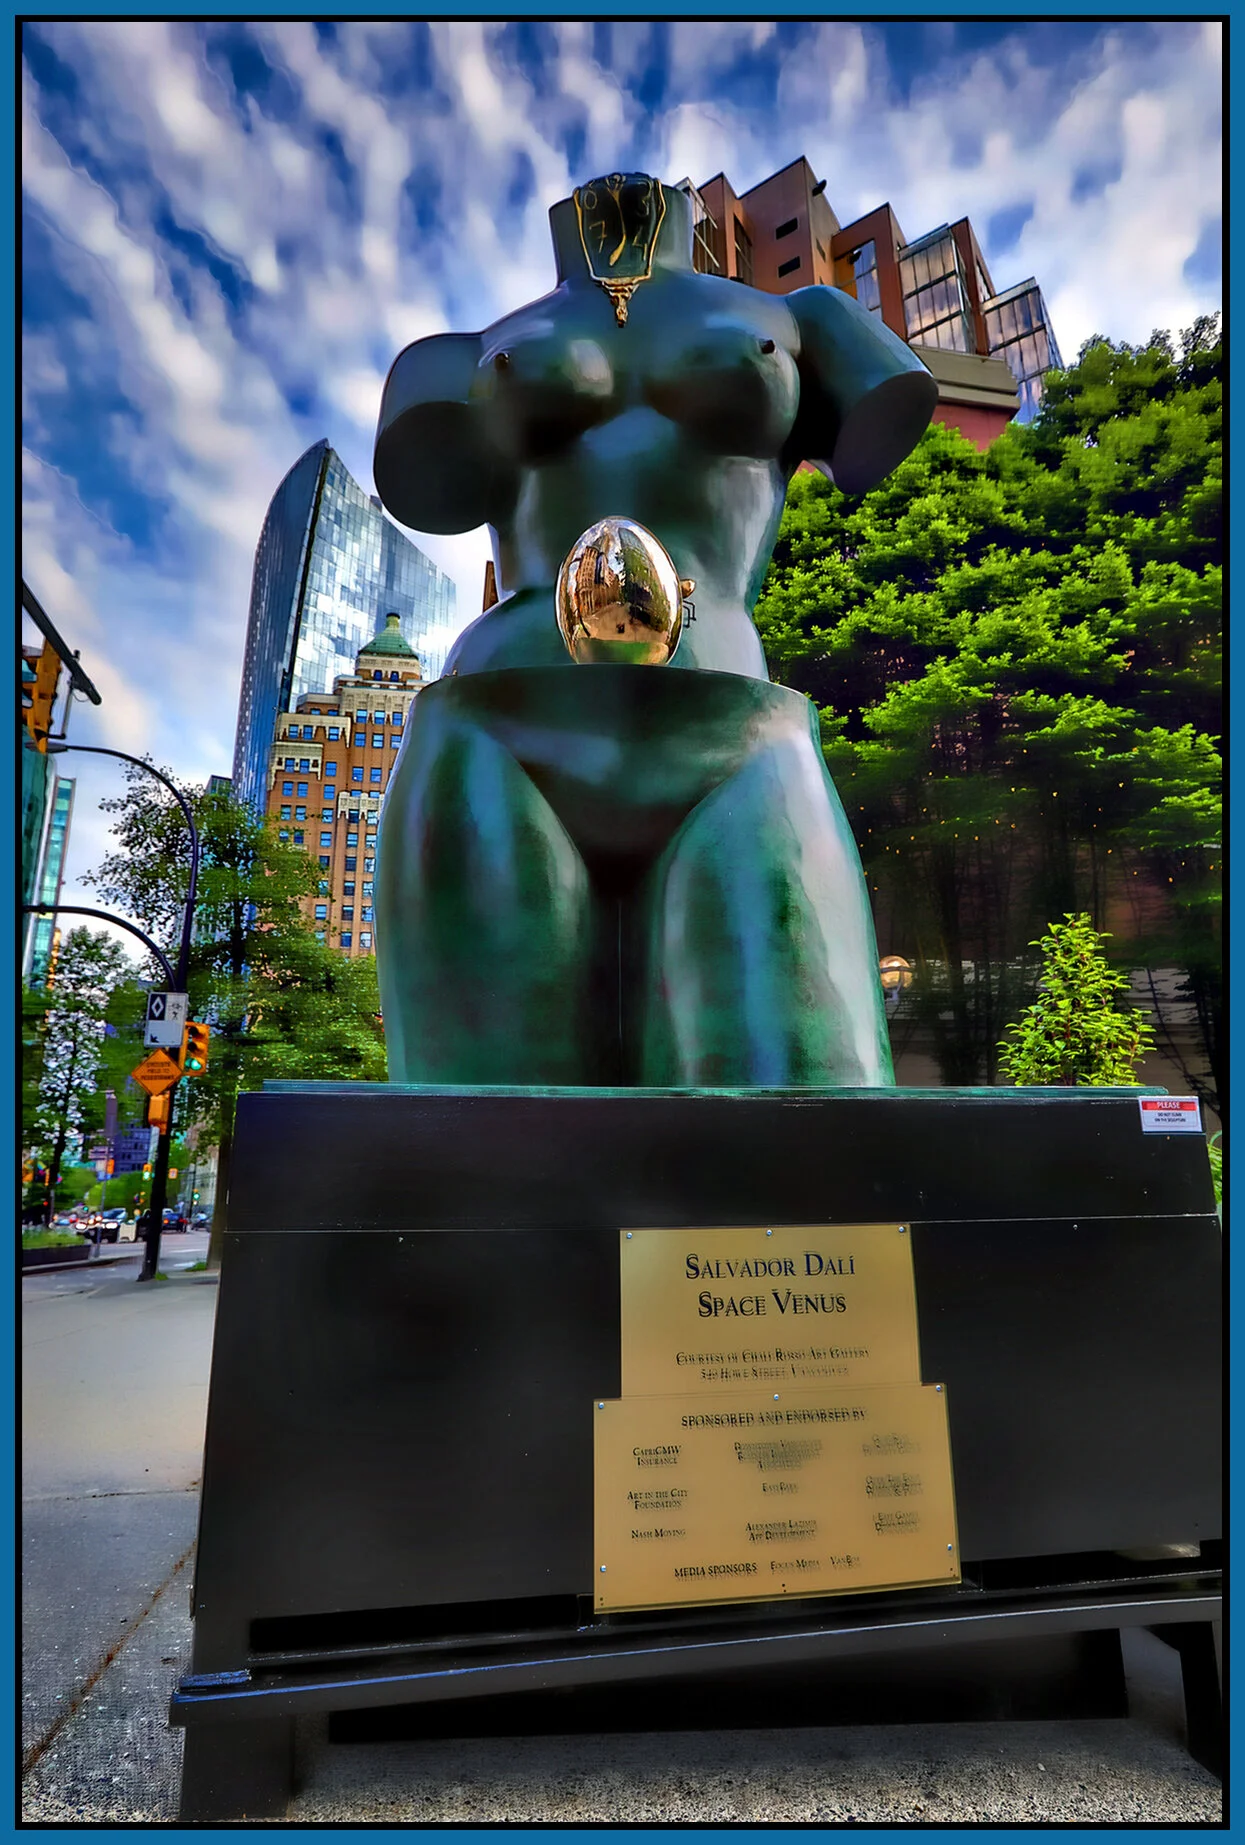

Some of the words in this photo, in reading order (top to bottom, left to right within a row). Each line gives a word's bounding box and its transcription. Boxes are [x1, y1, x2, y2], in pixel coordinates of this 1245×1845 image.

[589, 220, 607, 253] 7
[632, 225, 648, 262] 4
[1156, 1101, 1181, 1109] PLEASE
[681, 1412, 754, 1429] SPONSORED
[758, 1411, 784, 1426] AND
[786, 1408, 850, 1425] ENDORSED
[674, 1566, 706, 1578] MEDIA
[707, 1562, 758, 1576] SPONSORS
